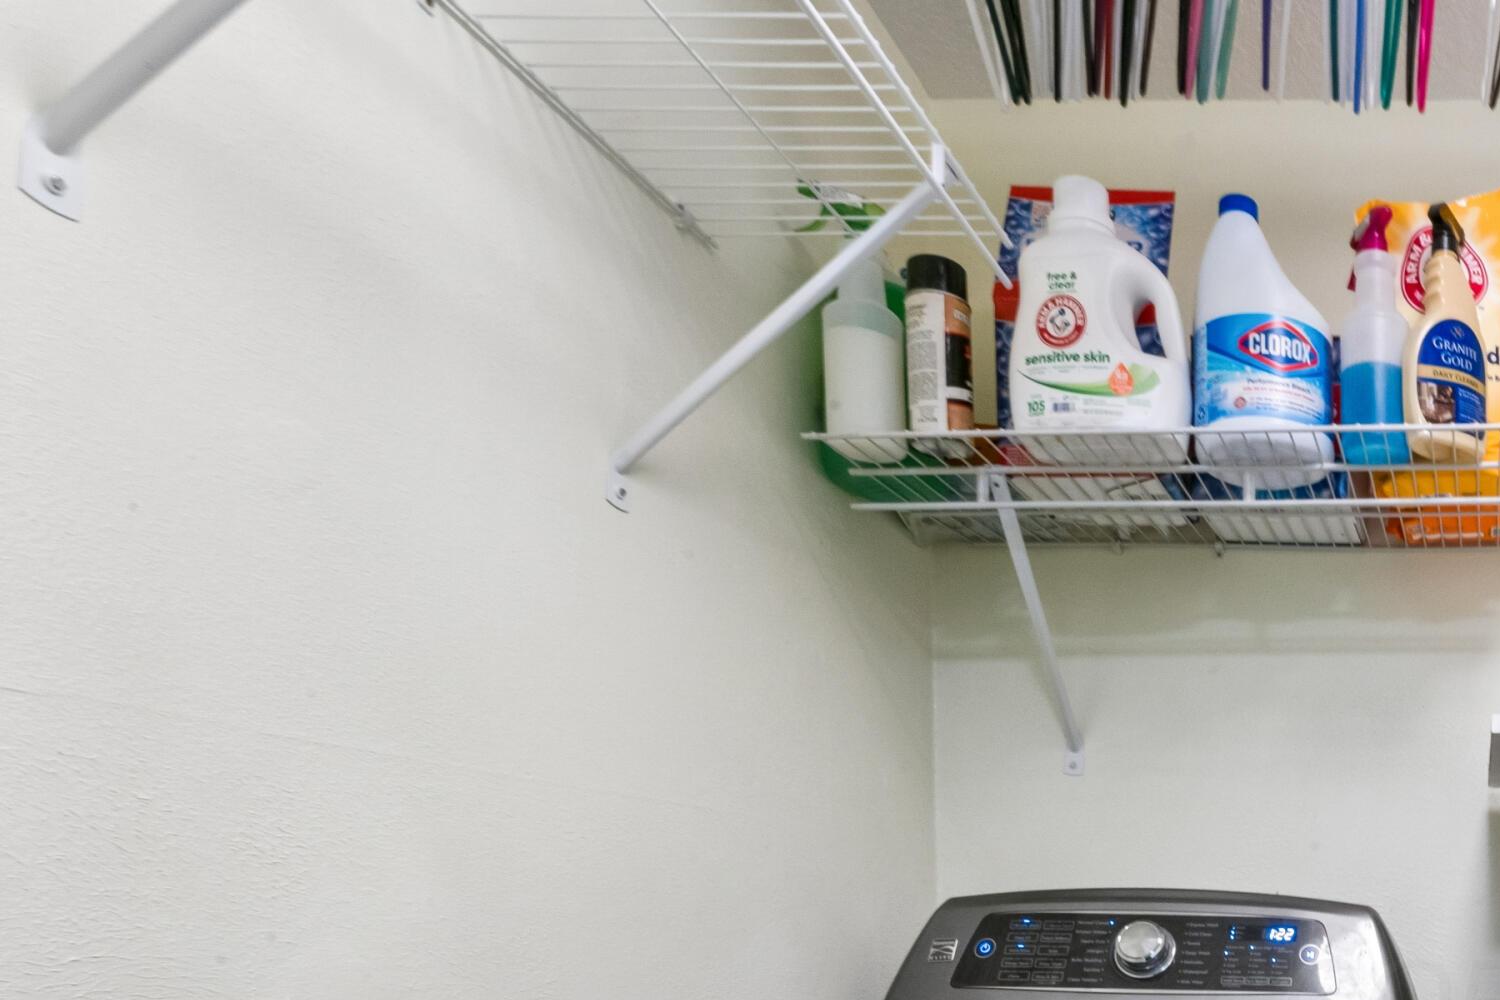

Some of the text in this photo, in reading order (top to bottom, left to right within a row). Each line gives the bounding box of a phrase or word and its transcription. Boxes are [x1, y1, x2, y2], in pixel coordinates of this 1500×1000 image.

[1406, 244, 1423, 284] ARM
[1025, 349, 1111, 366] sensitive skin
[1248, 332, 1312, 366] CLOROX
[1441, 350, 1472, 373] GOLD
[1027, 400, 1045, 413] 105
